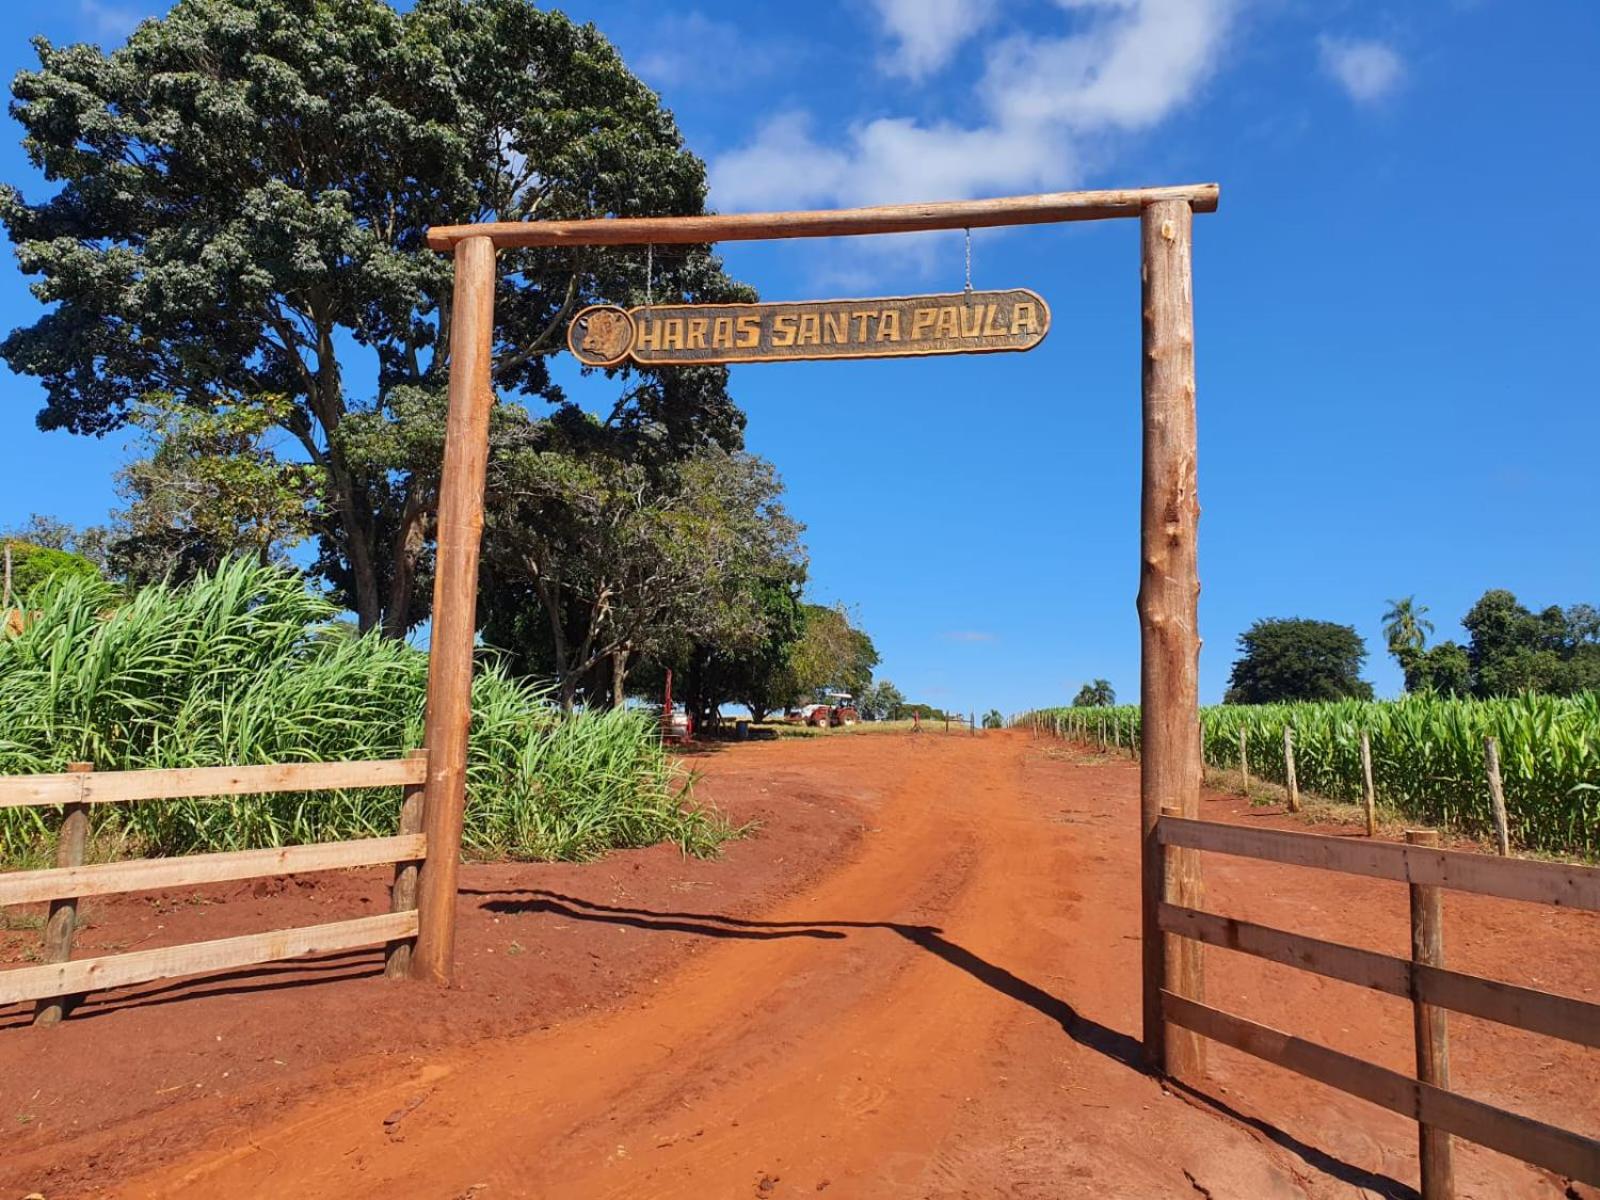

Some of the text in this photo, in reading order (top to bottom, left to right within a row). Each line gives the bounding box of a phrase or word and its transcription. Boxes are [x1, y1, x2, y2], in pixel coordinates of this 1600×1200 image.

[637, 302, 1039, 351] HARAS SANTA PAULA
